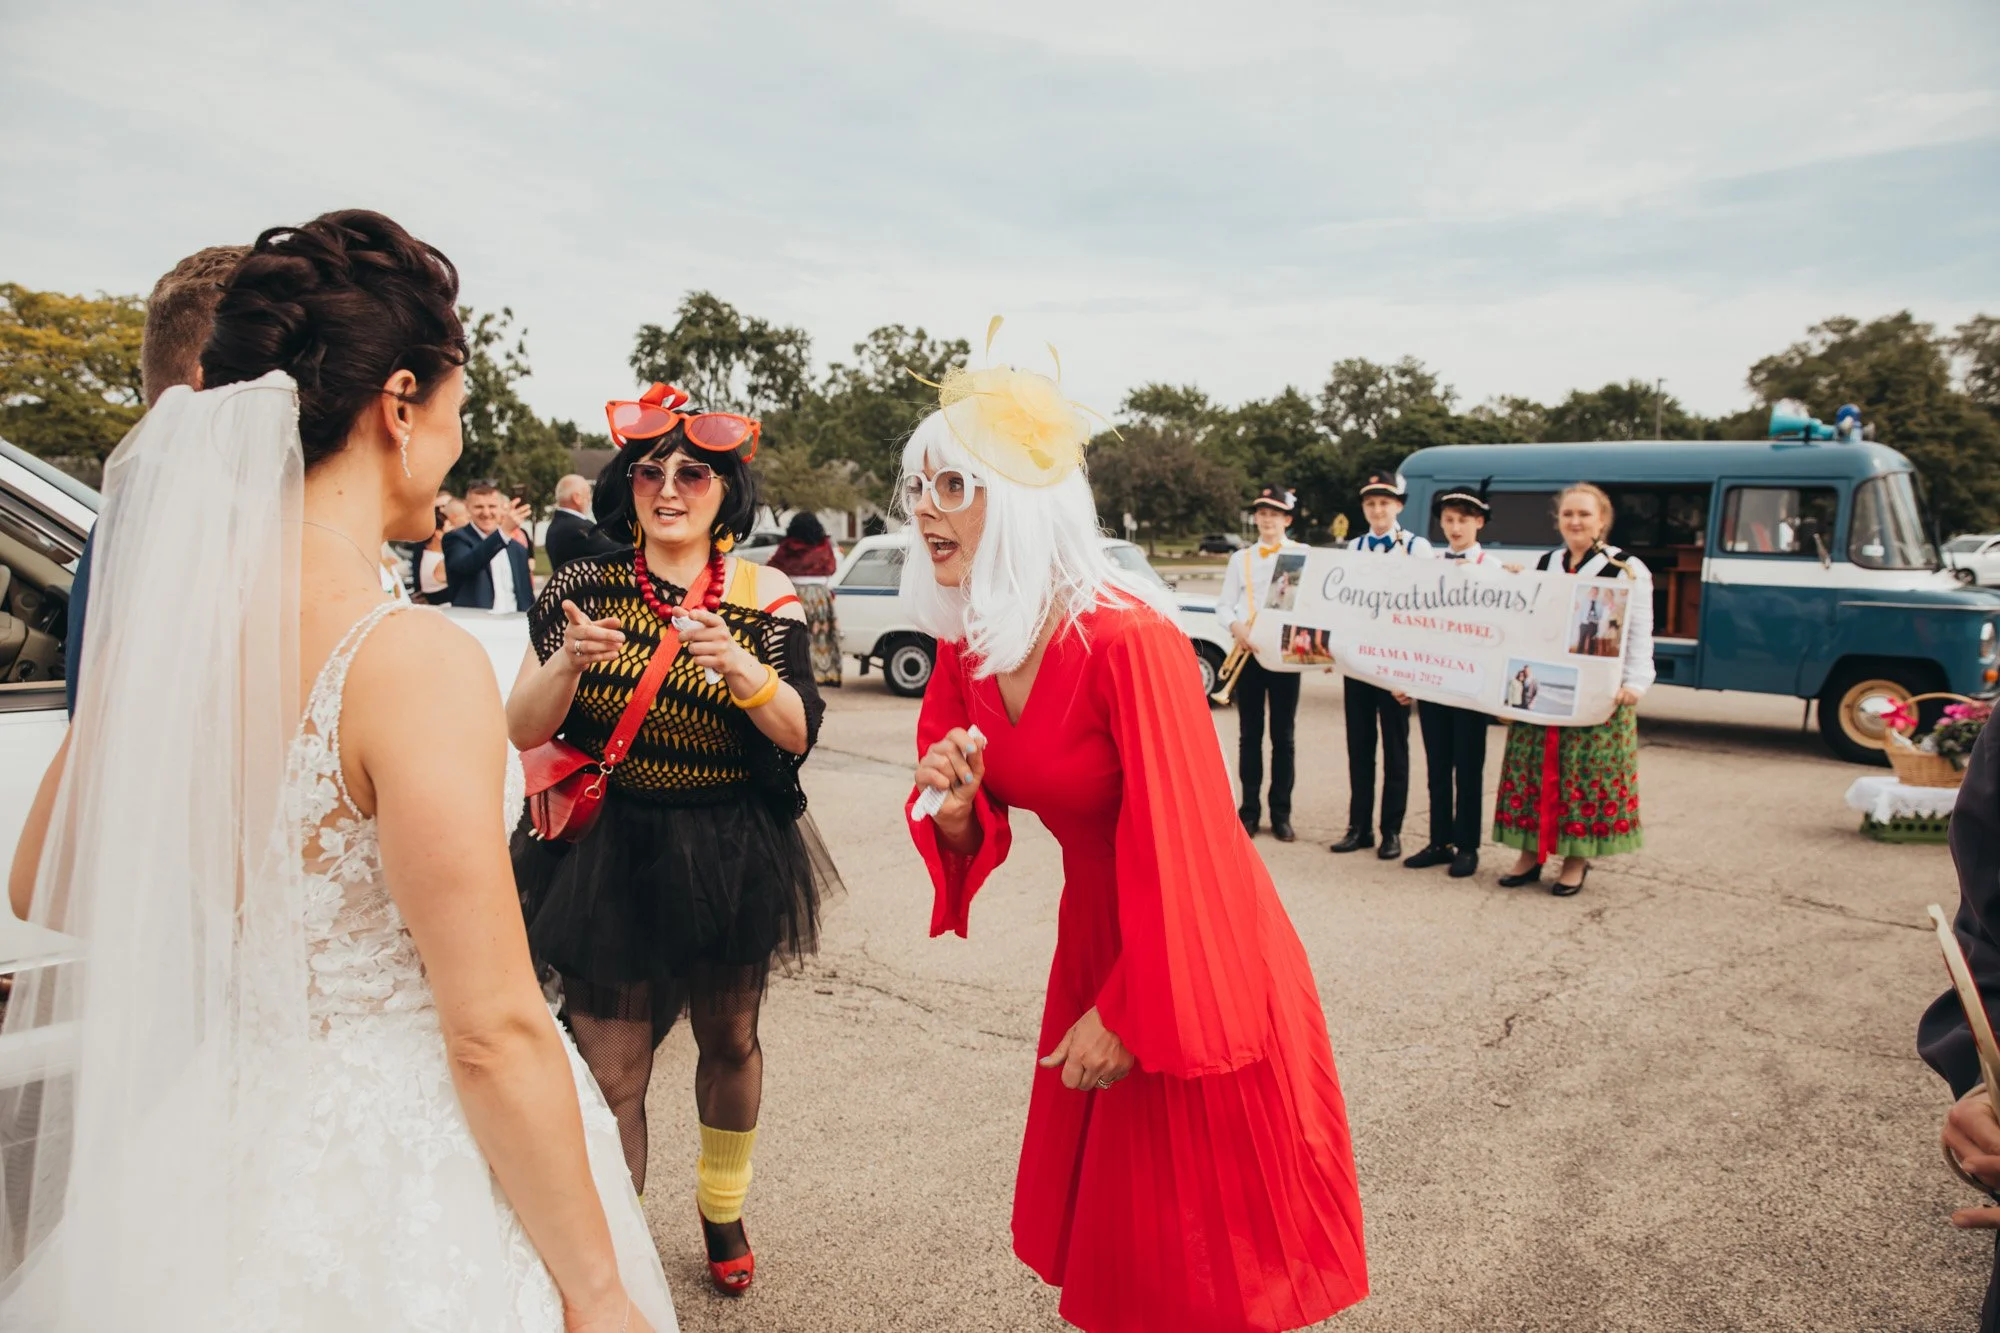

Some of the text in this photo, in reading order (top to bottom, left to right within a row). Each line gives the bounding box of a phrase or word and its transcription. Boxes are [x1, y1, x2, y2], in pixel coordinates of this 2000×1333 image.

[1322, 566, 1542, 620] Congratulations!
[1392, 613, 1436, 630] KASIA
[1358, 644, 1475, 674] BRAMA WESELNA
[1392, 669, 1416, 682] maj
[1419, 670, 1443, 686] 2022
